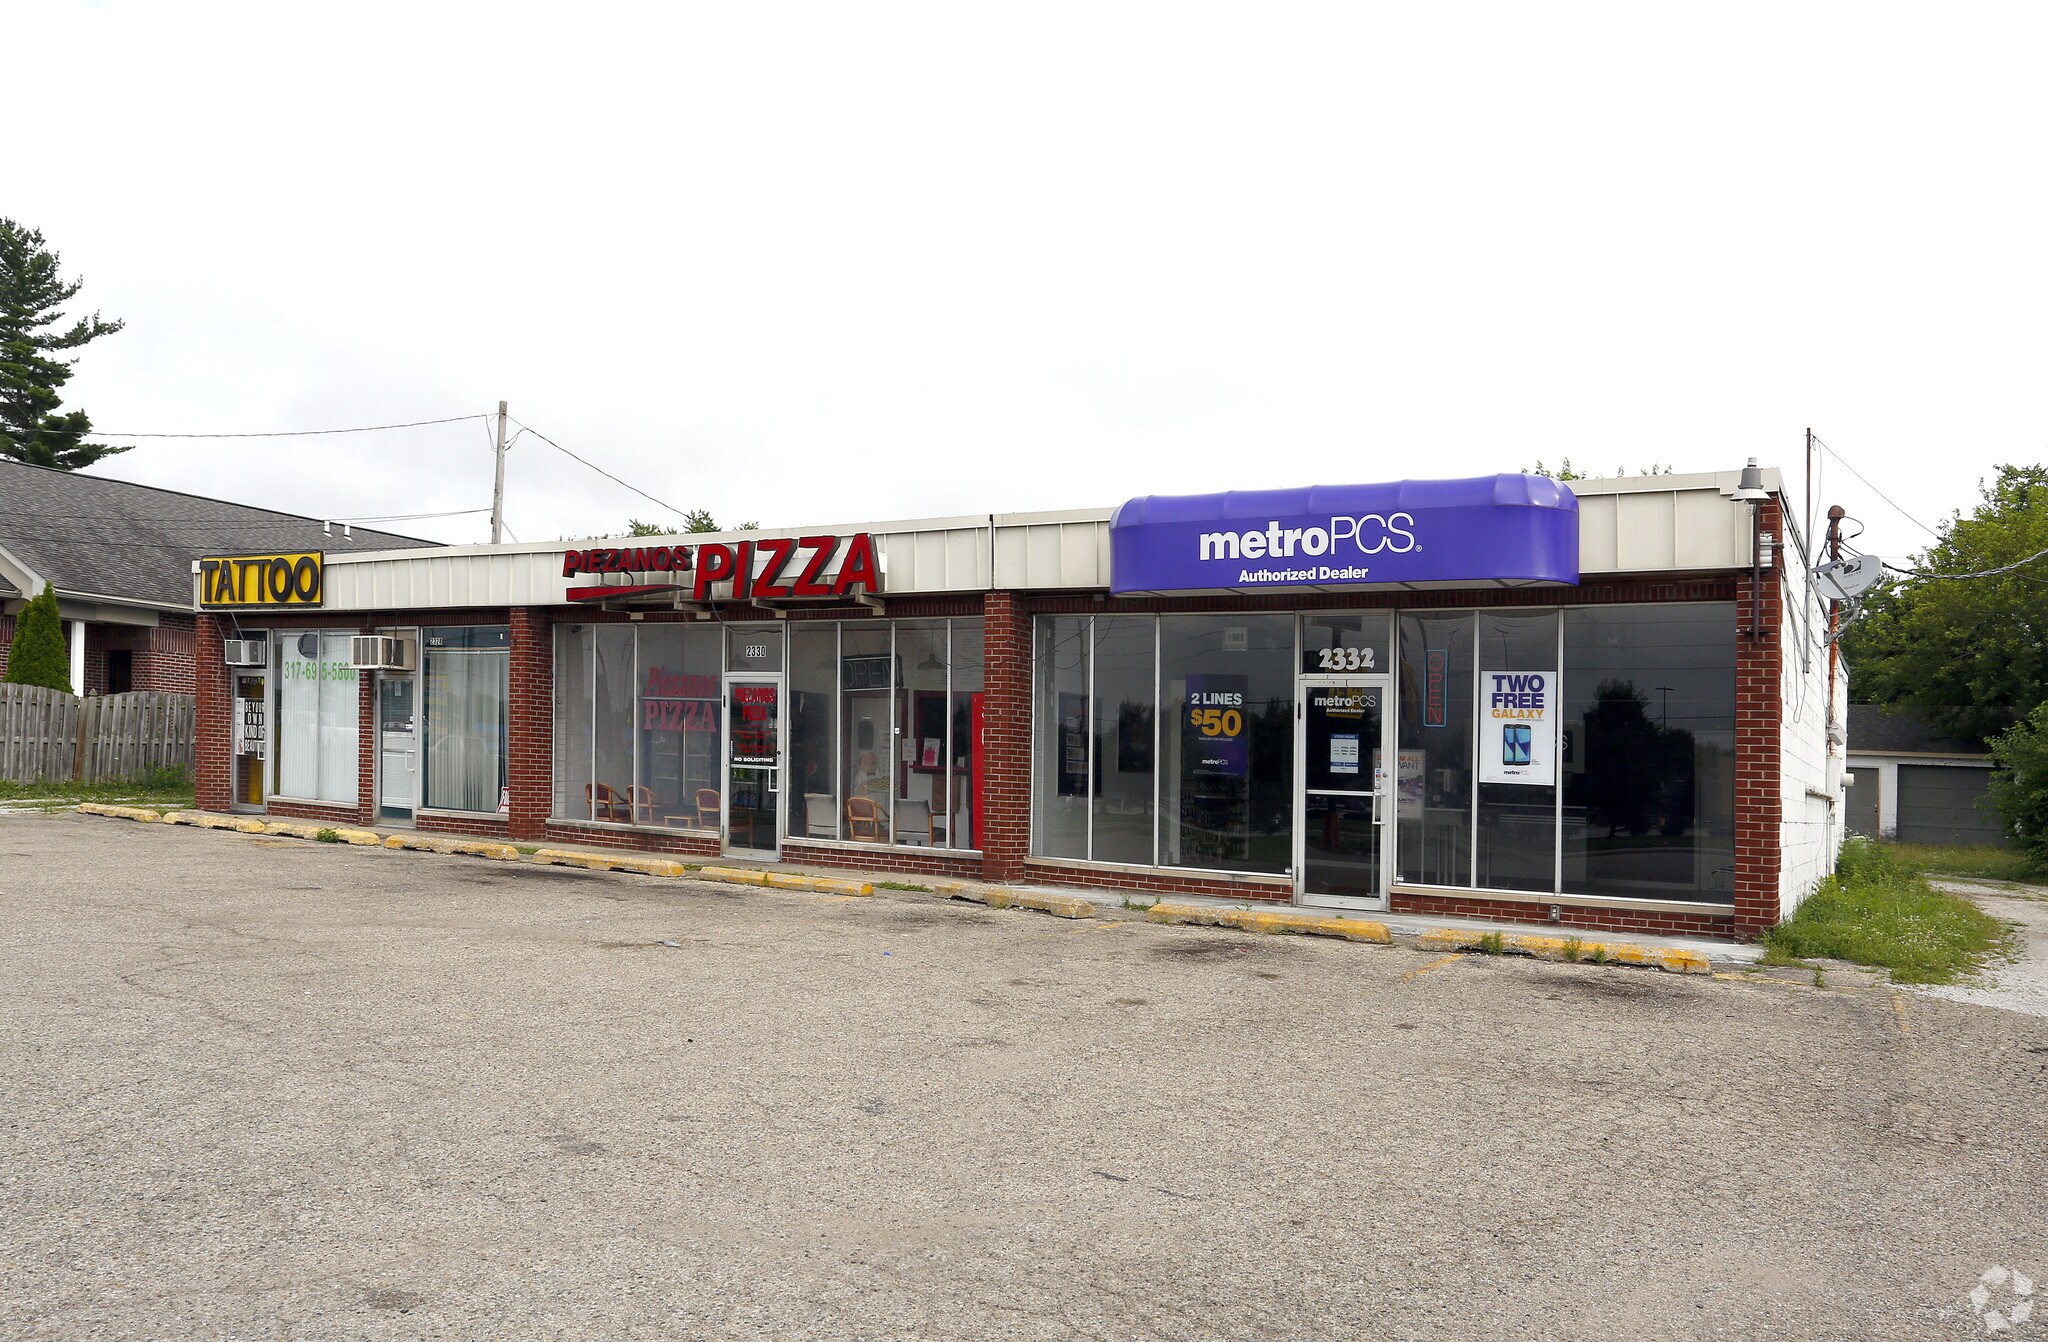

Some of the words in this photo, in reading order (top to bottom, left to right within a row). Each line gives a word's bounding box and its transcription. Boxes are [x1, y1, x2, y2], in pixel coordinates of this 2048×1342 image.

[563, 545, 692, 578] PIEZANOS
[693, 533, 882, 600] PIZZA
[1238, 567, 1316, 583] Authorized
[1319, 565, 1369, 580] Dealer
[200, 556, 319, 602] TATTOO
[746, 645, 766, 657] 2330
[1319, 647, 1375, 671] 2332
[1428, 653, 1445, 723] OPEN
[1492, 675, 1545, 692] TWO
[1190, 692, 1200, 705] 2
[1202, 692, 1243, 705] LINES
[1314, 695, 1377, 708] metroPCS
[1492, 693, 1544, 708] FREE
[644, 700, 717, 732] PIZZA
[742, 705, 768, 721] PIZZA
[1491, 709, 1545, 719] GALAXY
[1190, 707, 1242, 737] $50
